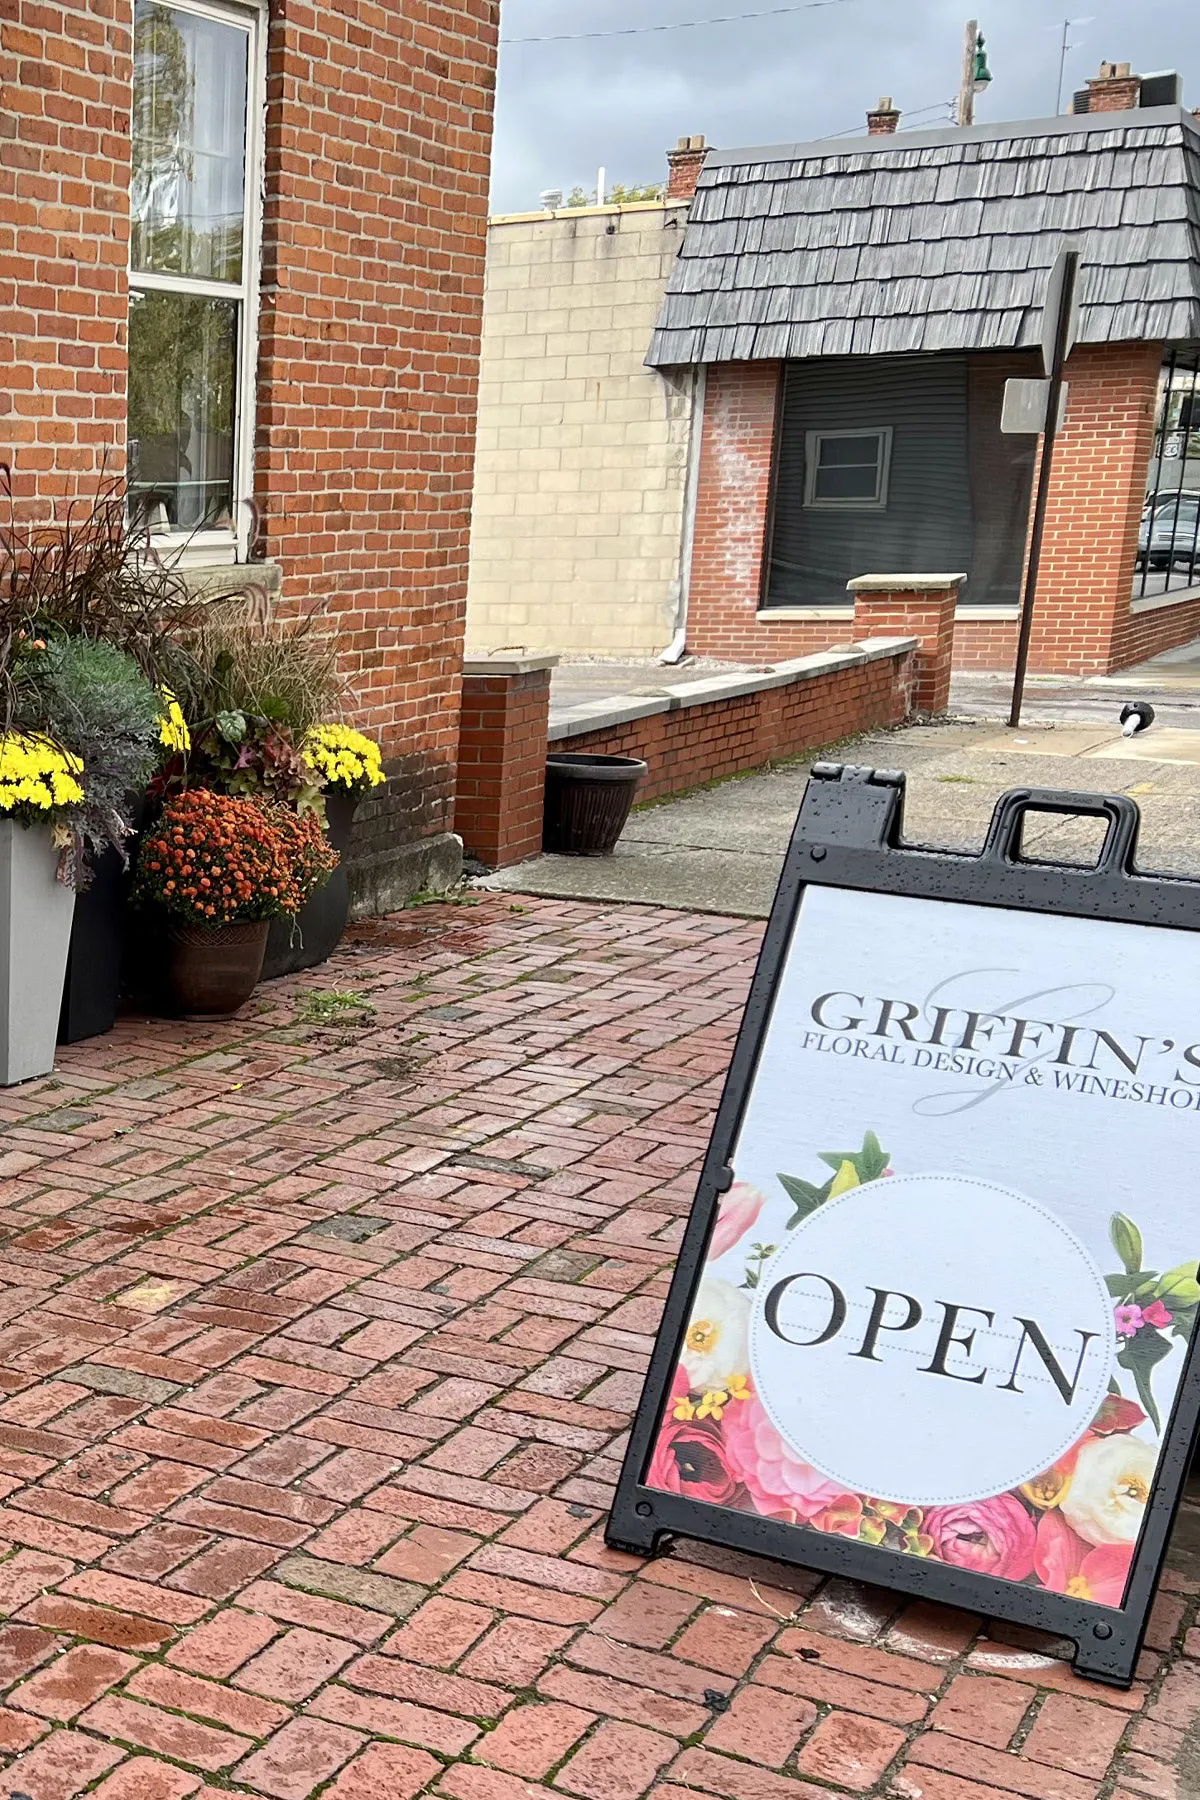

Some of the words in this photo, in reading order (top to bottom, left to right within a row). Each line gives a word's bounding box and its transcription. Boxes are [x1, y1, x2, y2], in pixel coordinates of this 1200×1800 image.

[801, 1031, 905, 1064] FLORAL
[912, 1048, 1019, 1082] DESIGN
[1024, 1066, 1044, 1087] &
[1053, 1069, 1200, 1111] WINESHO
[764, 1272, 1101, 1406] OPEN
